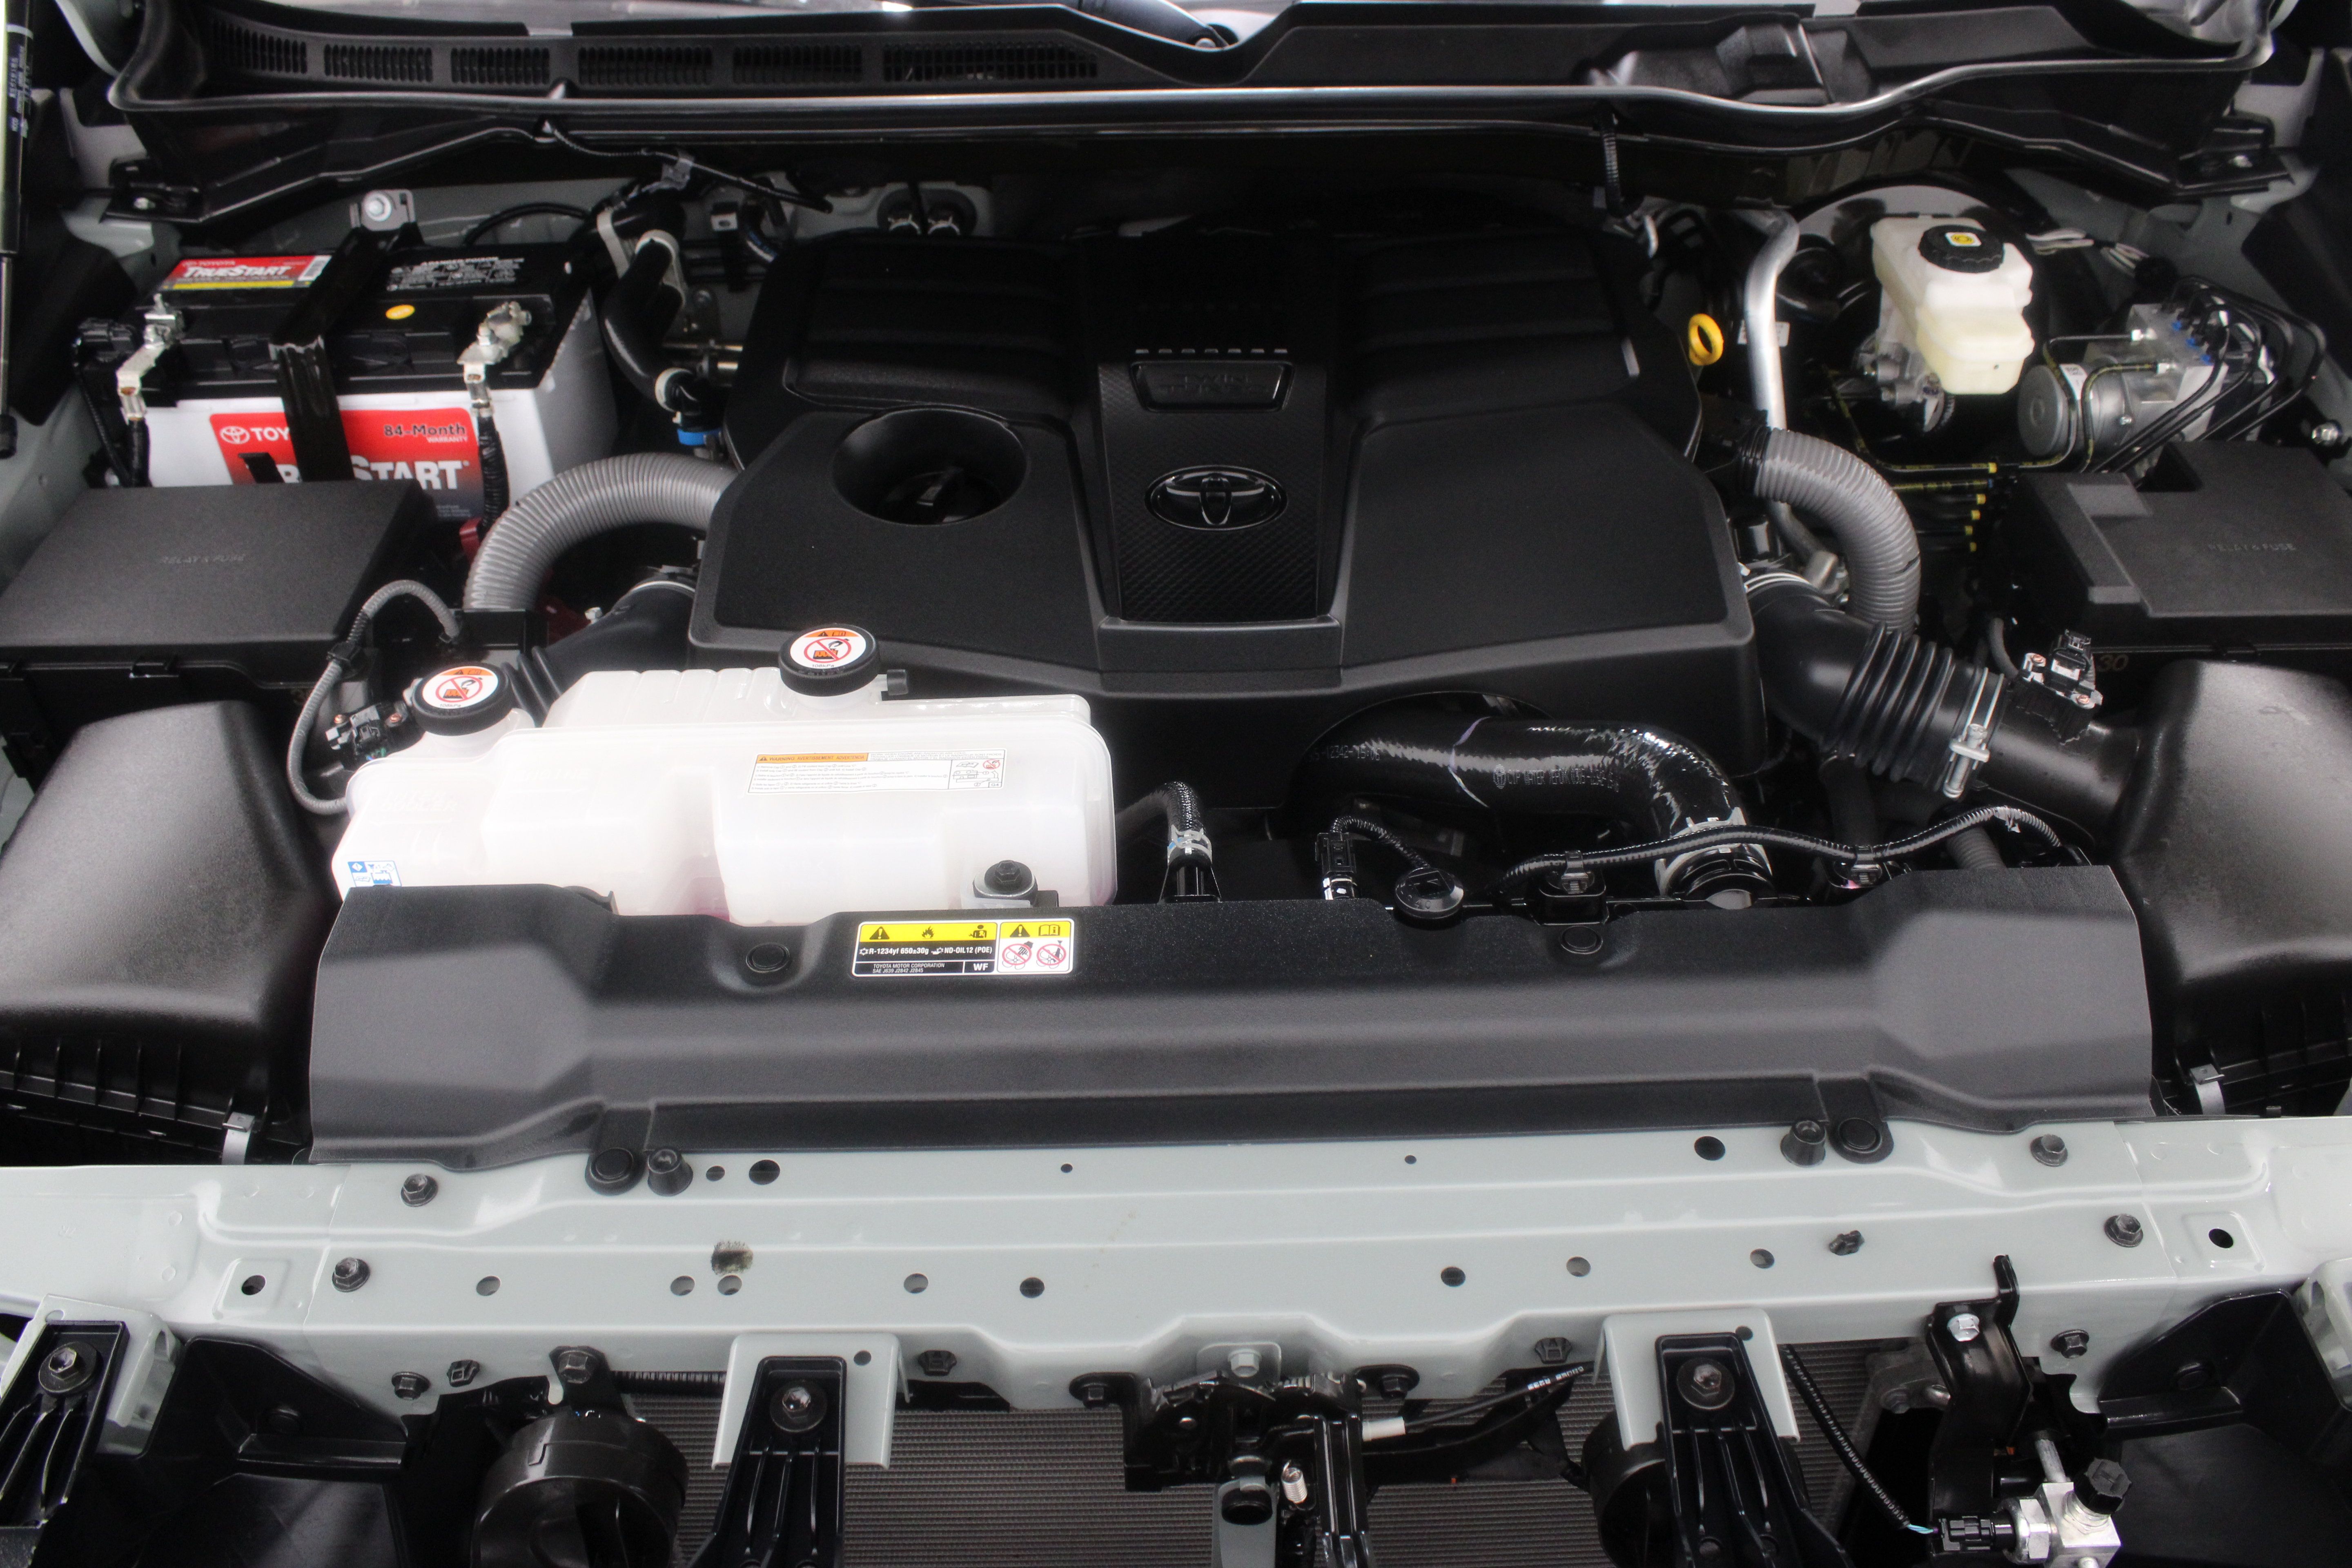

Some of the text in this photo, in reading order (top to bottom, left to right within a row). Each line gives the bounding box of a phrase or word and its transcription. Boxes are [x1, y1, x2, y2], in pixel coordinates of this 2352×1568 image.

[251, 427, 291, 441] TOY
[383, 422, 466, 437] 84-Month
[427, 435, 468, 443] WARRANTY
[869, 947, 899, 956] R-1234yf
[900, 947, 929, 955] 650±30g
[975, 946, 992, 954] (POE)
[973, 963, 989, 971] WF
